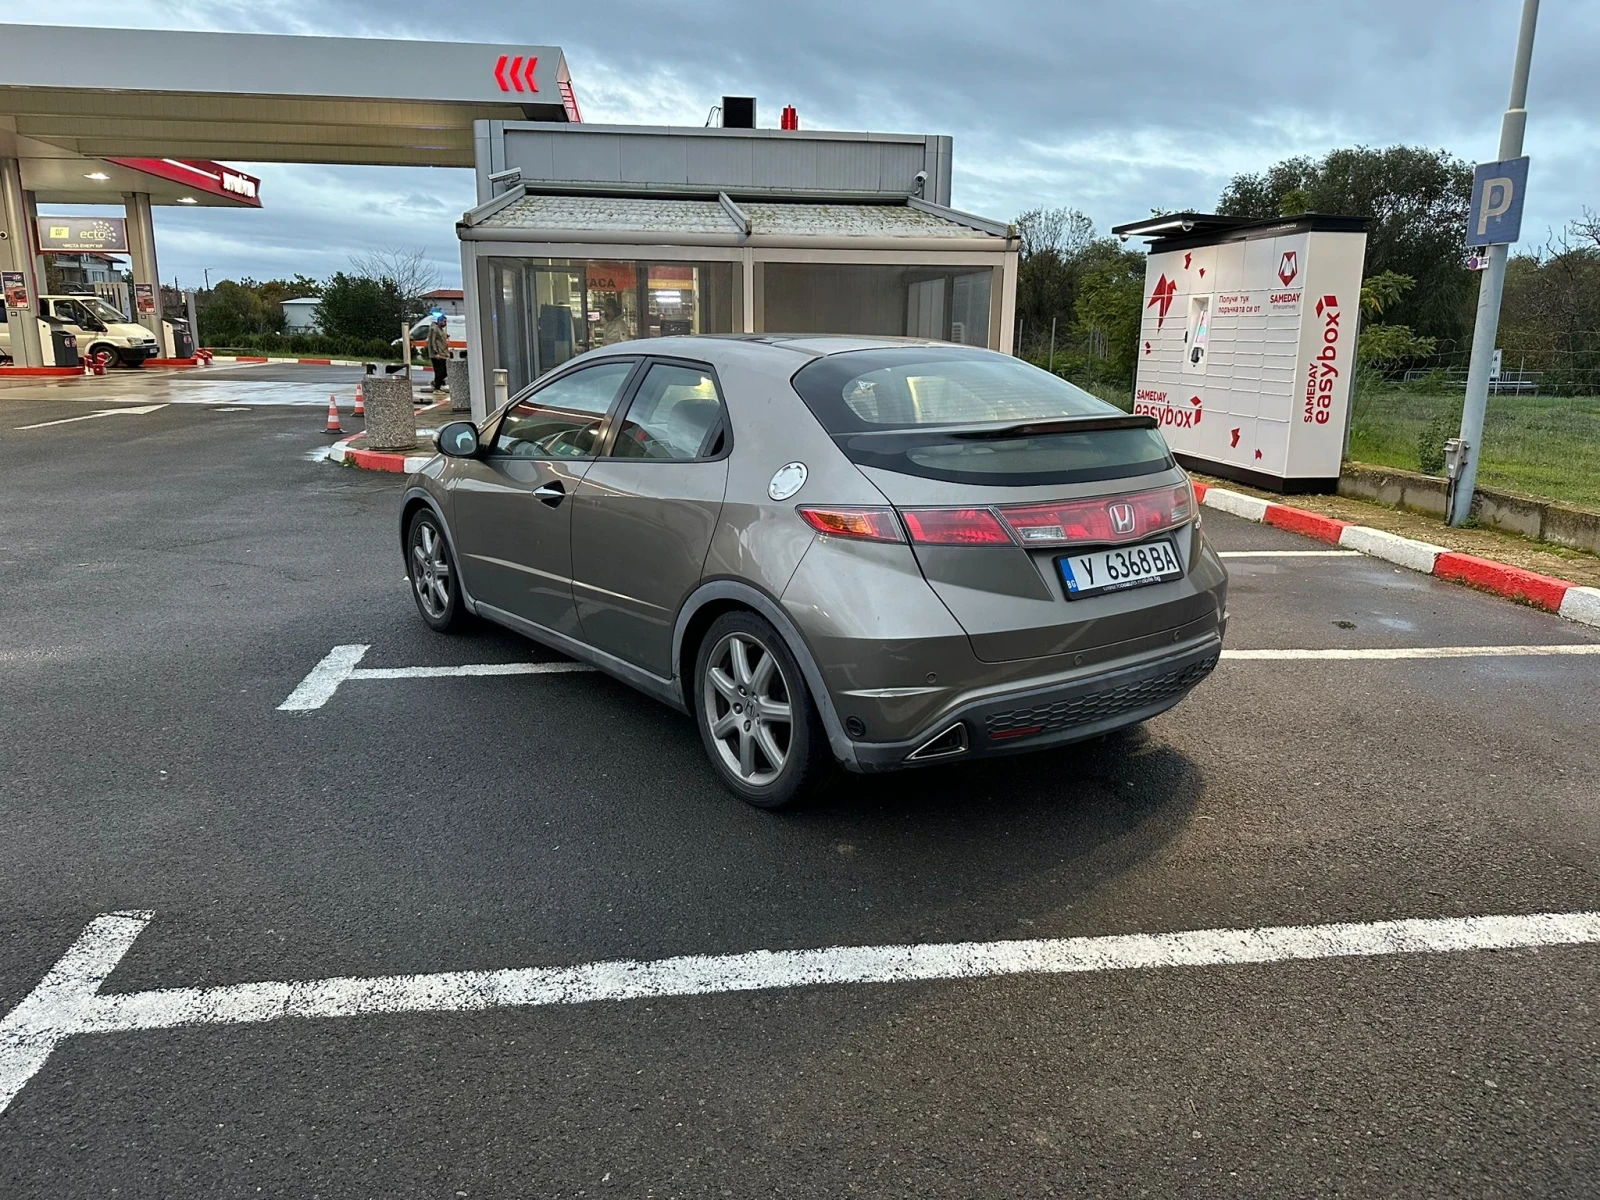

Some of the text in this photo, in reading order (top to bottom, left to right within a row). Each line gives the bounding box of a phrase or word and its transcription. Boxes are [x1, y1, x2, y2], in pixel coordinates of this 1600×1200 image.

[1477, 177, 1513, 235] P
[79, 229, 106, 239] ecto
[1218, 295, 1249, 304] Получи тук
[1269, 292, 1301, 304] SAMEDAY
[1314, 311, 1340, 425] easybox
[1136, 389, 1168, 403] SAMEDAY
[1304, 362, 1318, 423] SAMEDAY
[1066, 579, 1077, 589] BG
